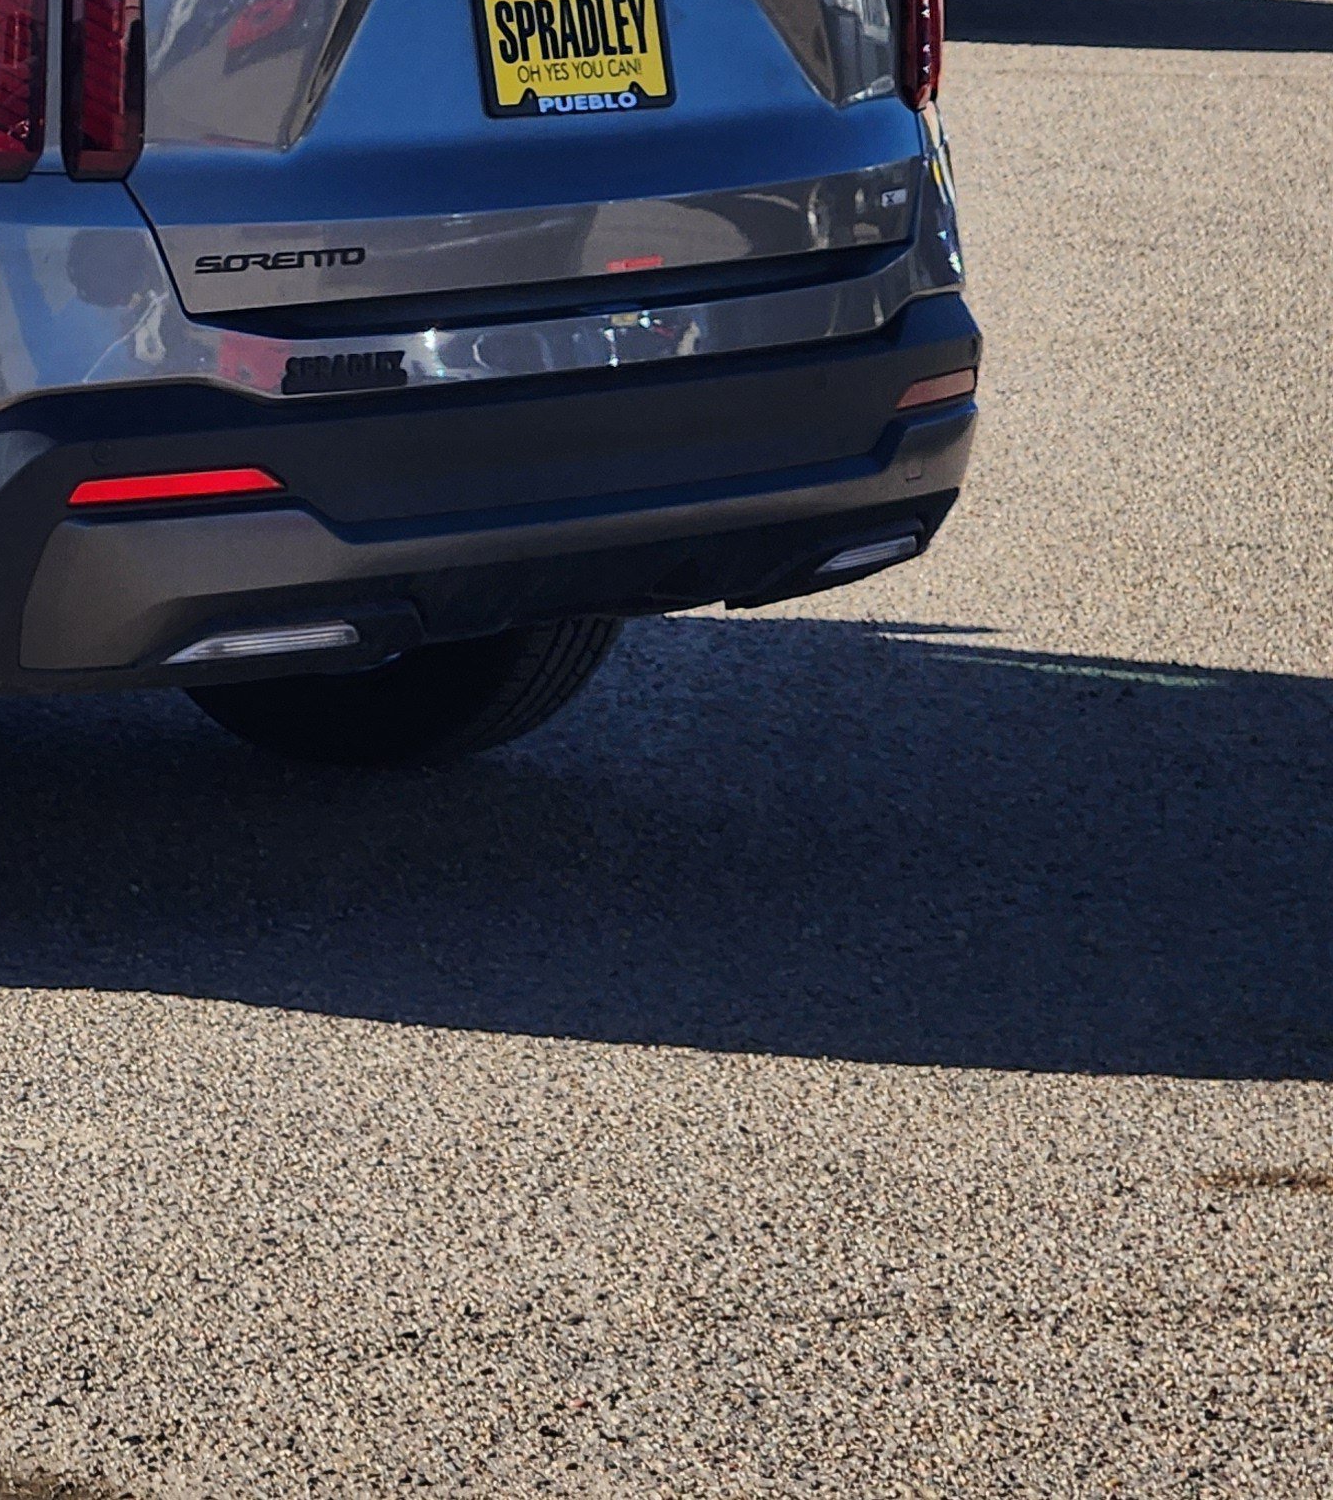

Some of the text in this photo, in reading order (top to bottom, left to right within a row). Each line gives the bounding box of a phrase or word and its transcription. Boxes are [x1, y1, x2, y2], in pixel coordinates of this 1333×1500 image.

[517, 58, 643, 84] OH YES YOU CAN!
[538, 91, 638, 113] PUEBLO
[194, 247, 367, 275] SORENTO
